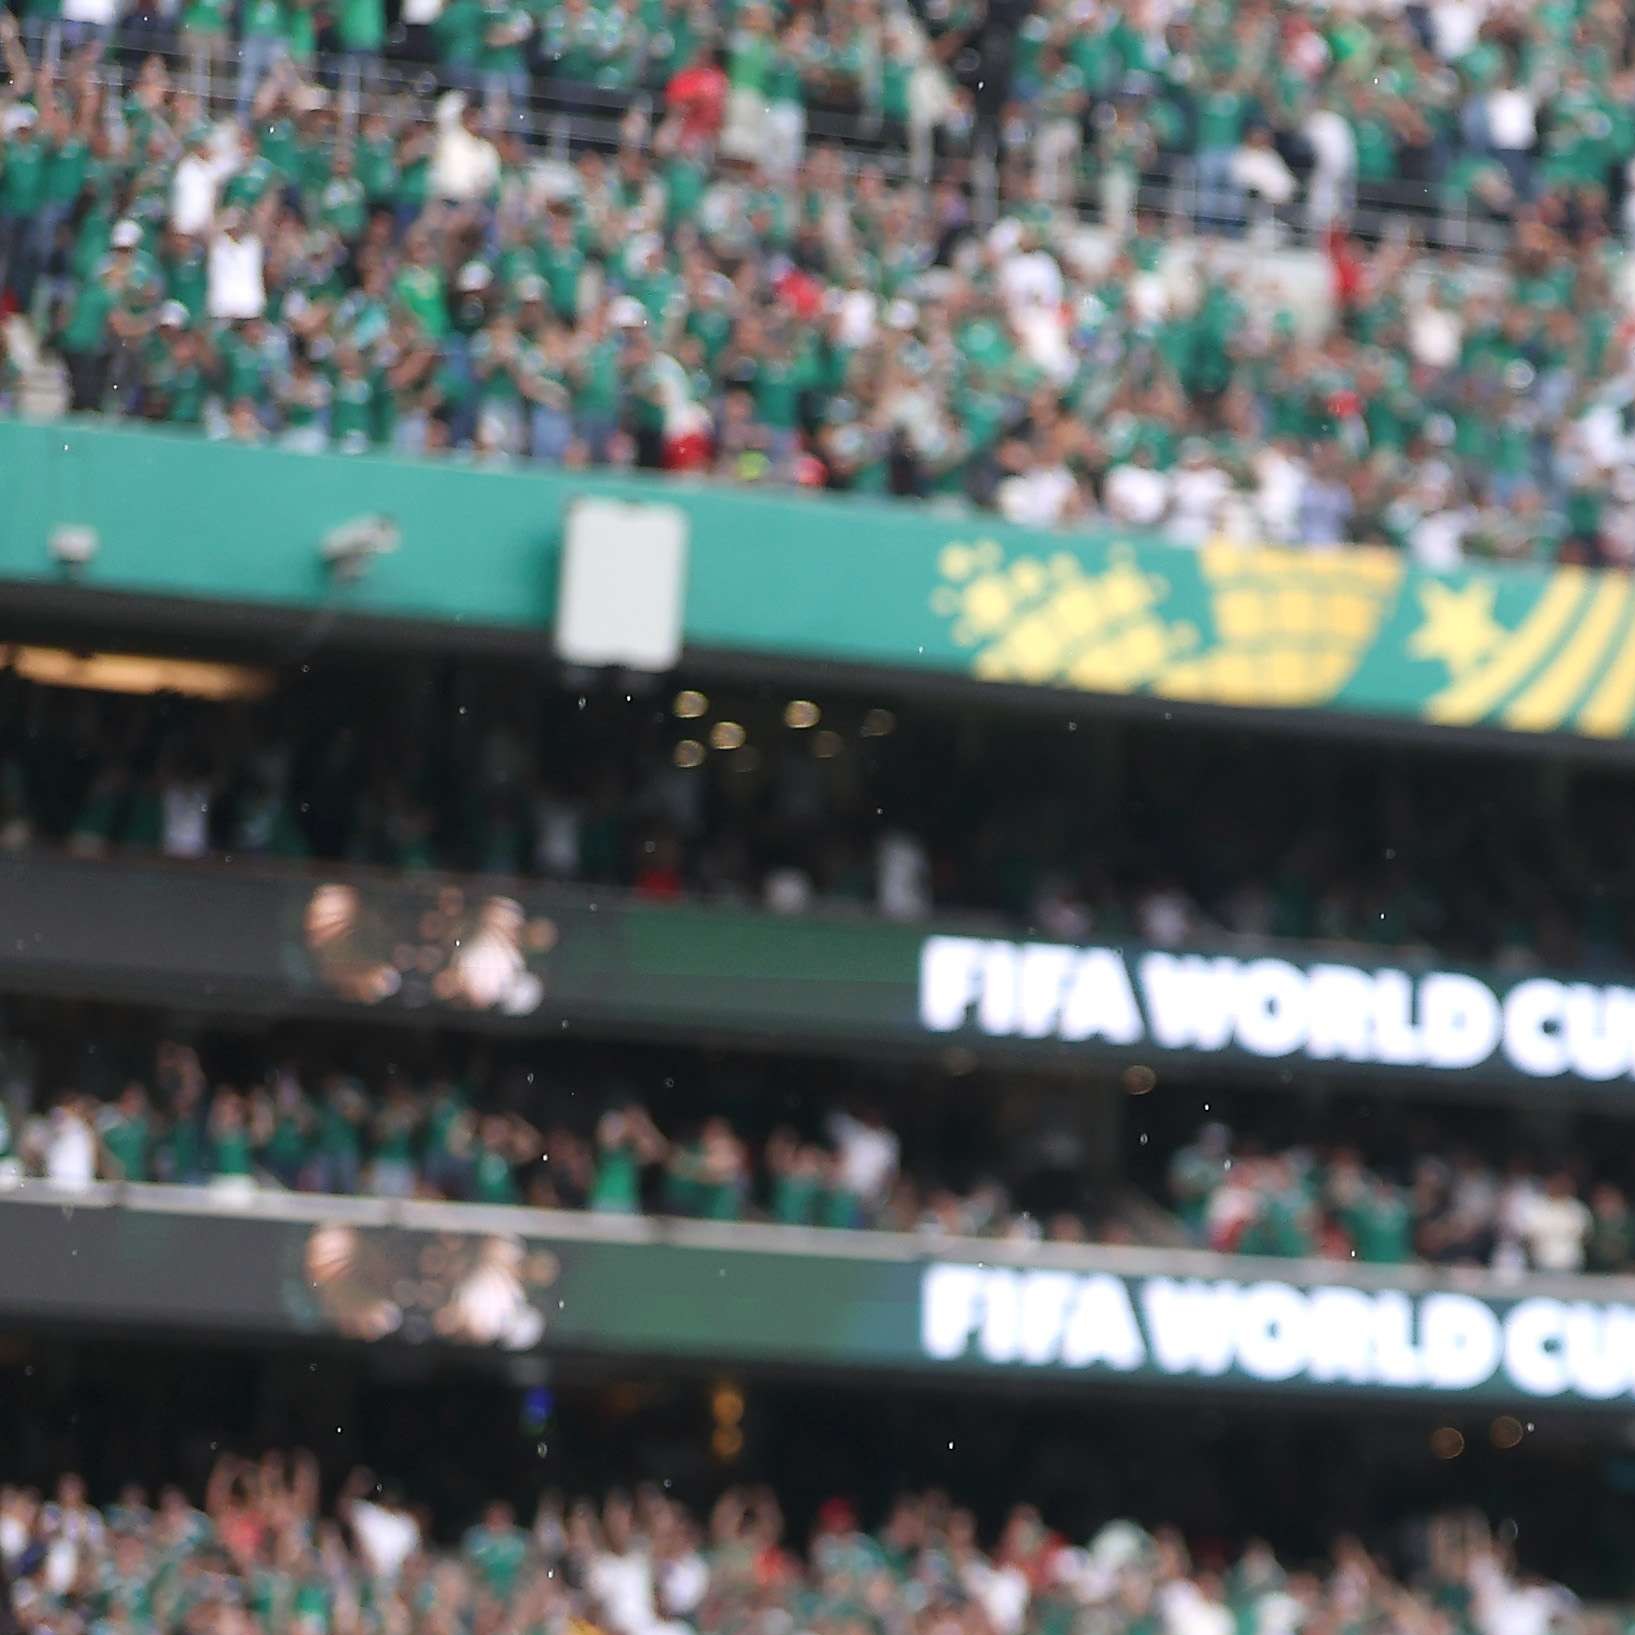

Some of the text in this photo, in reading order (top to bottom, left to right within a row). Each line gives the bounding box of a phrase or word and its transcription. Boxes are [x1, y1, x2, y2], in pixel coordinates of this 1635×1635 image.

[922, 937, 1144, 1045] FIFA
[1146, 954, 1501, 1069] WORLD
[922, 1266, 1144, 1370] FIFA
[1146, 1280, 1501, 1386] WORLD
